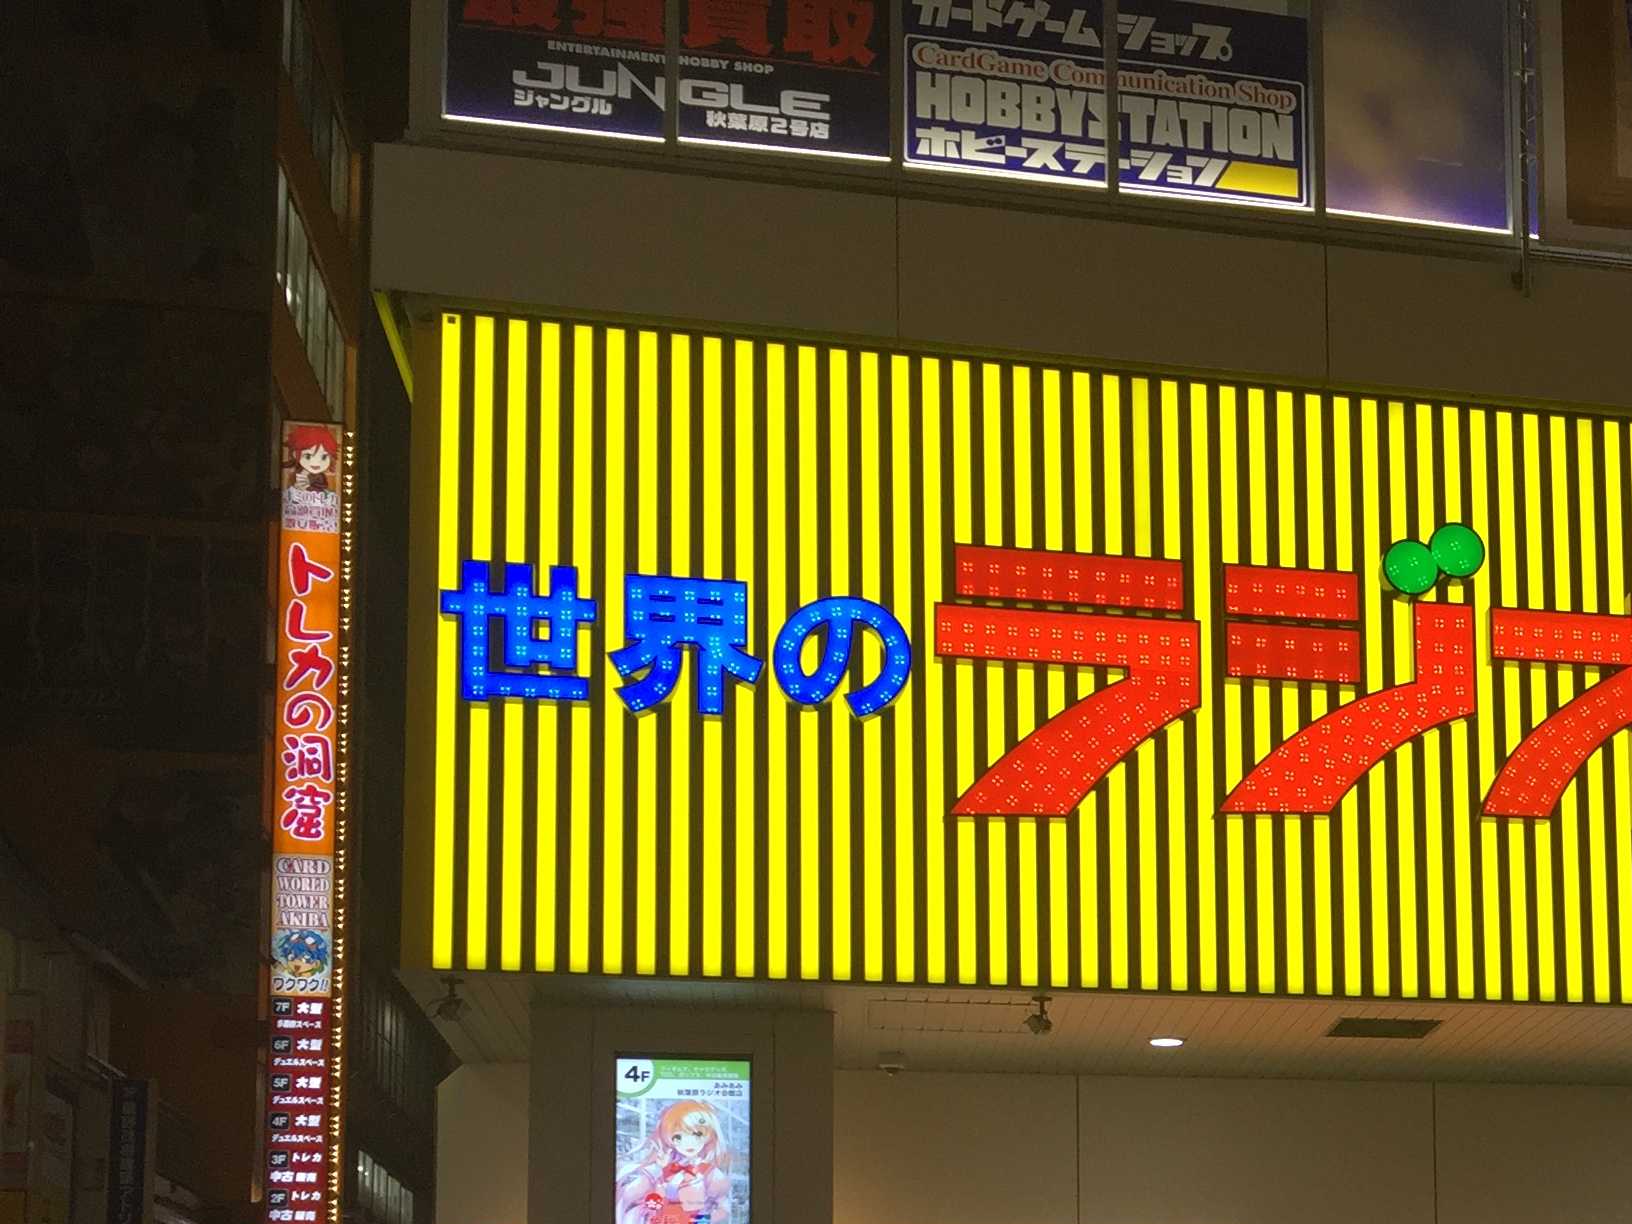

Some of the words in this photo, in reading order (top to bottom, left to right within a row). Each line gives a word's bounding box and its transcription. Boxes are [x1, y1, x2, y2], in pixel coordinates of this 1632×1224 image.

[677, 55, 729, 73] HOBBY
[732, 61, 773, 75] SHOP
[912, 44, 1046, 80] CardGame
[1053, 55, 1232, 102] Communication
[1236, 81, 1297, 113] Shop
[512, 61, 831, 121] JUNGLE
[513, 88, 614, 116] ジャングル
[705, 110, 830, 139] 秋葉原2号店
[914, 128, 1232, 188] ホビーステーション
[276, 857, 331, 875] CARD
[277, 876, 330, 893] WORLD
[277, 894, 329, 910] TOWER
[278, 911, 329, 928] AKIBA
[275, 1002, 291, 1013] 7F
[273, 1039, 290, 1051] 6F
[272, 1077, 289, 1088] 5F
[624, 1065, 651, 1083] 4F
[271, 1115, 288, 1127] 4F
[271, 1154, 287, 1166] 3F
[291, 1152, 322, 1163] トレカ
[269, 1193, 286, 1204] 2F
[290, 1190, 321, 1202] トレカ
